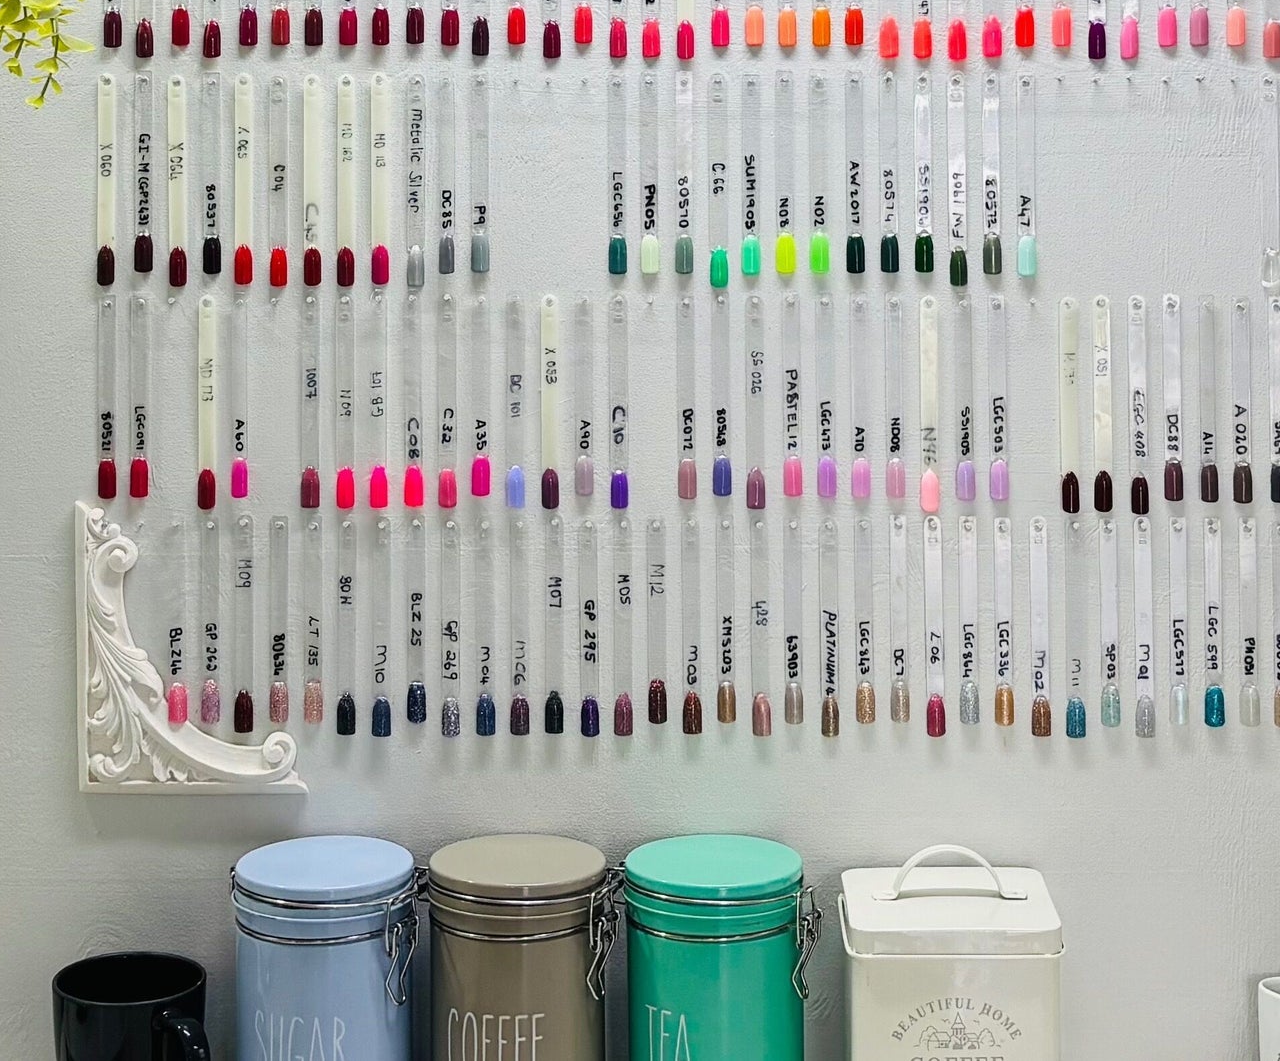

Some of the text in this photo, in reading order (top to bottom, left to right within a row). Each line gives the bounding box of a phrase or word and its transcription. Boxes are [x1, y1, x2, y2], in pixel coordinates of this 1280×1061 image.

[814, 196, 824, 226] N02
[476, 420, 487, 450] A35
[580, 420, 590, 449] A90
[855, 427, 864, 451] A70
[1203, 432, 1213, 454] A14
[644, 1004, 691, 1061] TEA
[891, 997, 1023, 1041] BEAUTIFUL HOME
[254, 1010, 346, 1061] SUGAR
